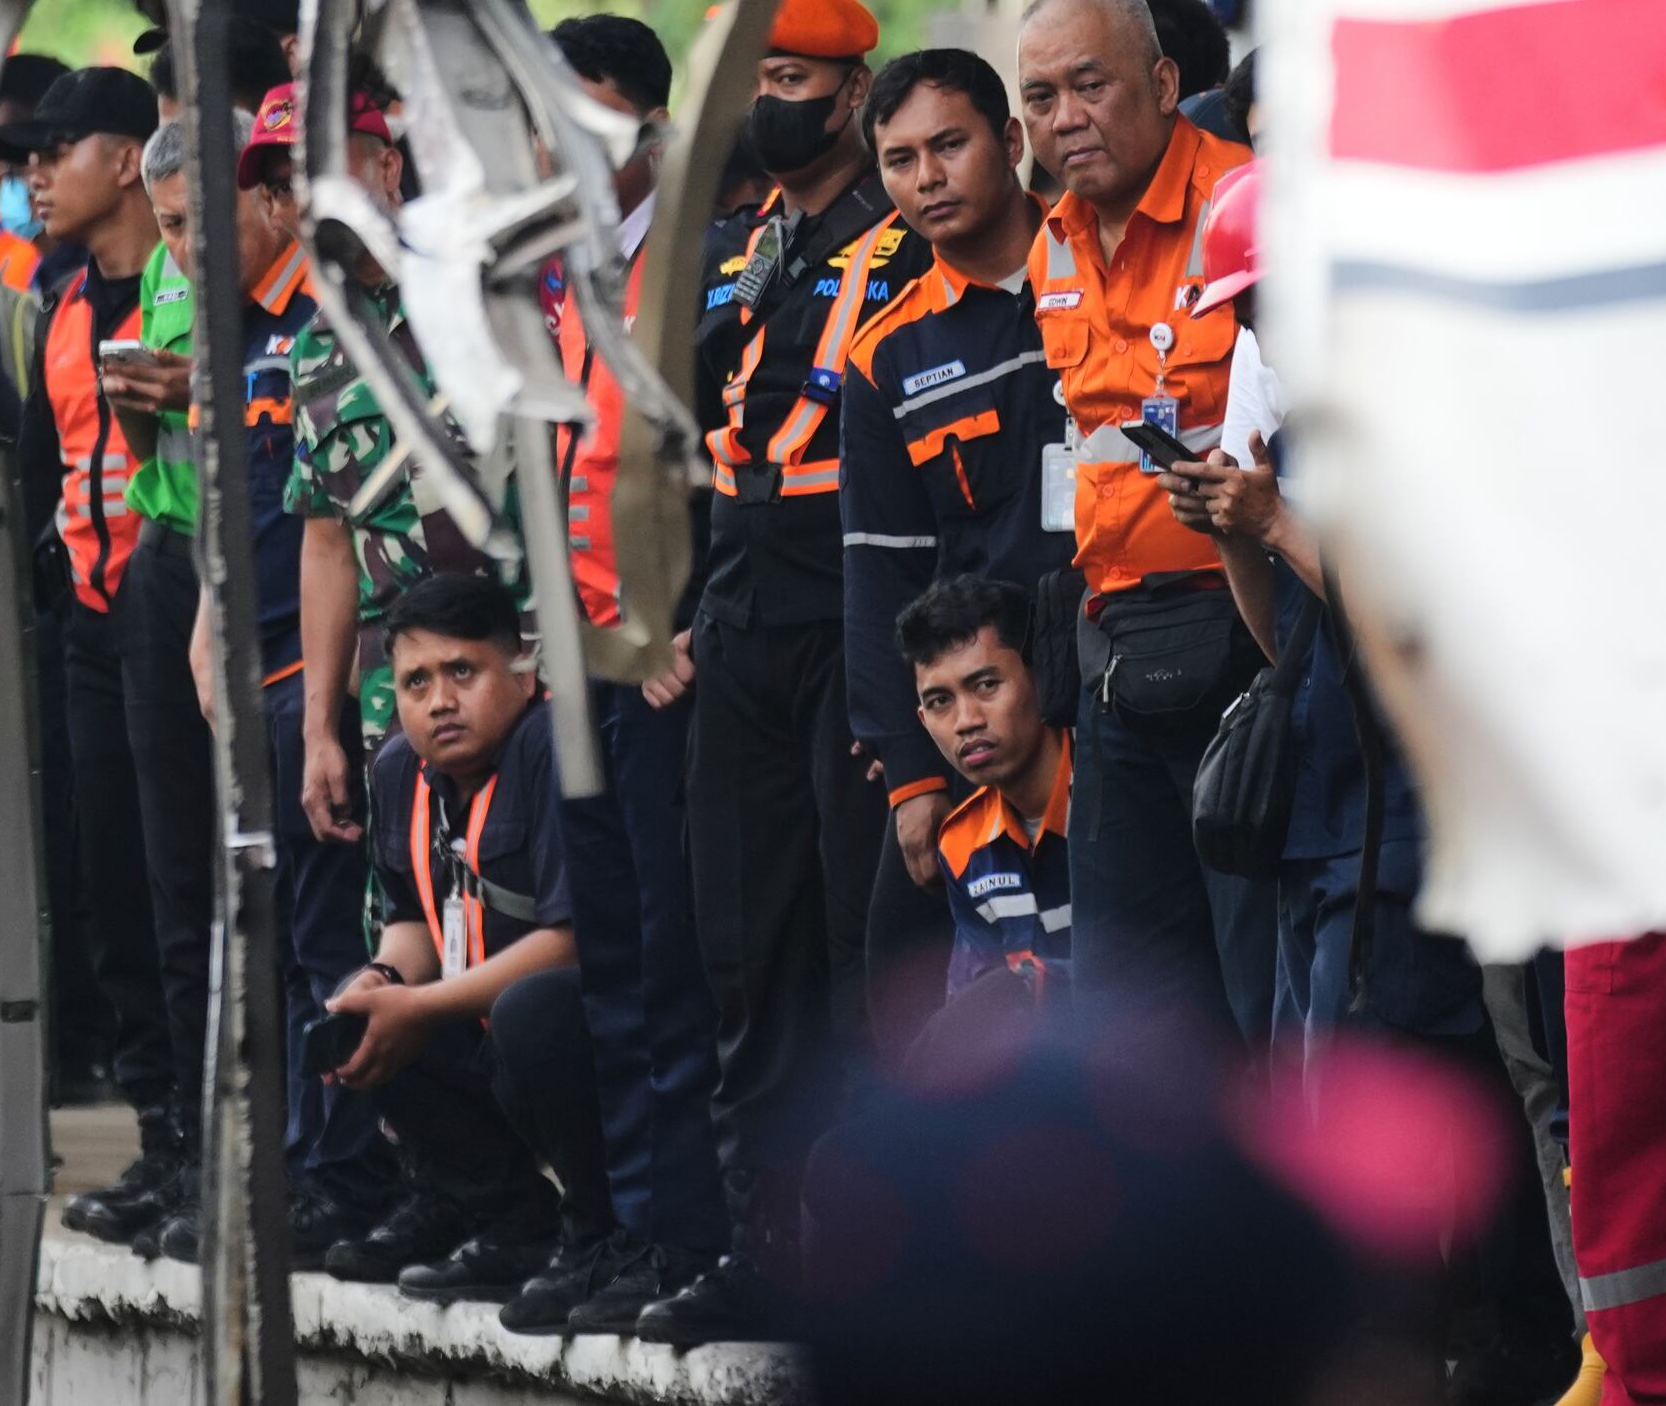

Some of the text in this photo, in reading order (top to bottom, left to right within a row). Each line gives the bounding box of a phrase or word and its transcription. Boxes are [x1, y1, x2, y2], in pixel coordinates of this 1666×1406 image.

[813, 278, 889, 301] POLKA
[914, 367, 954, 388] SEPTIAN
[973, 875, 1016, 894] ZAINUL
